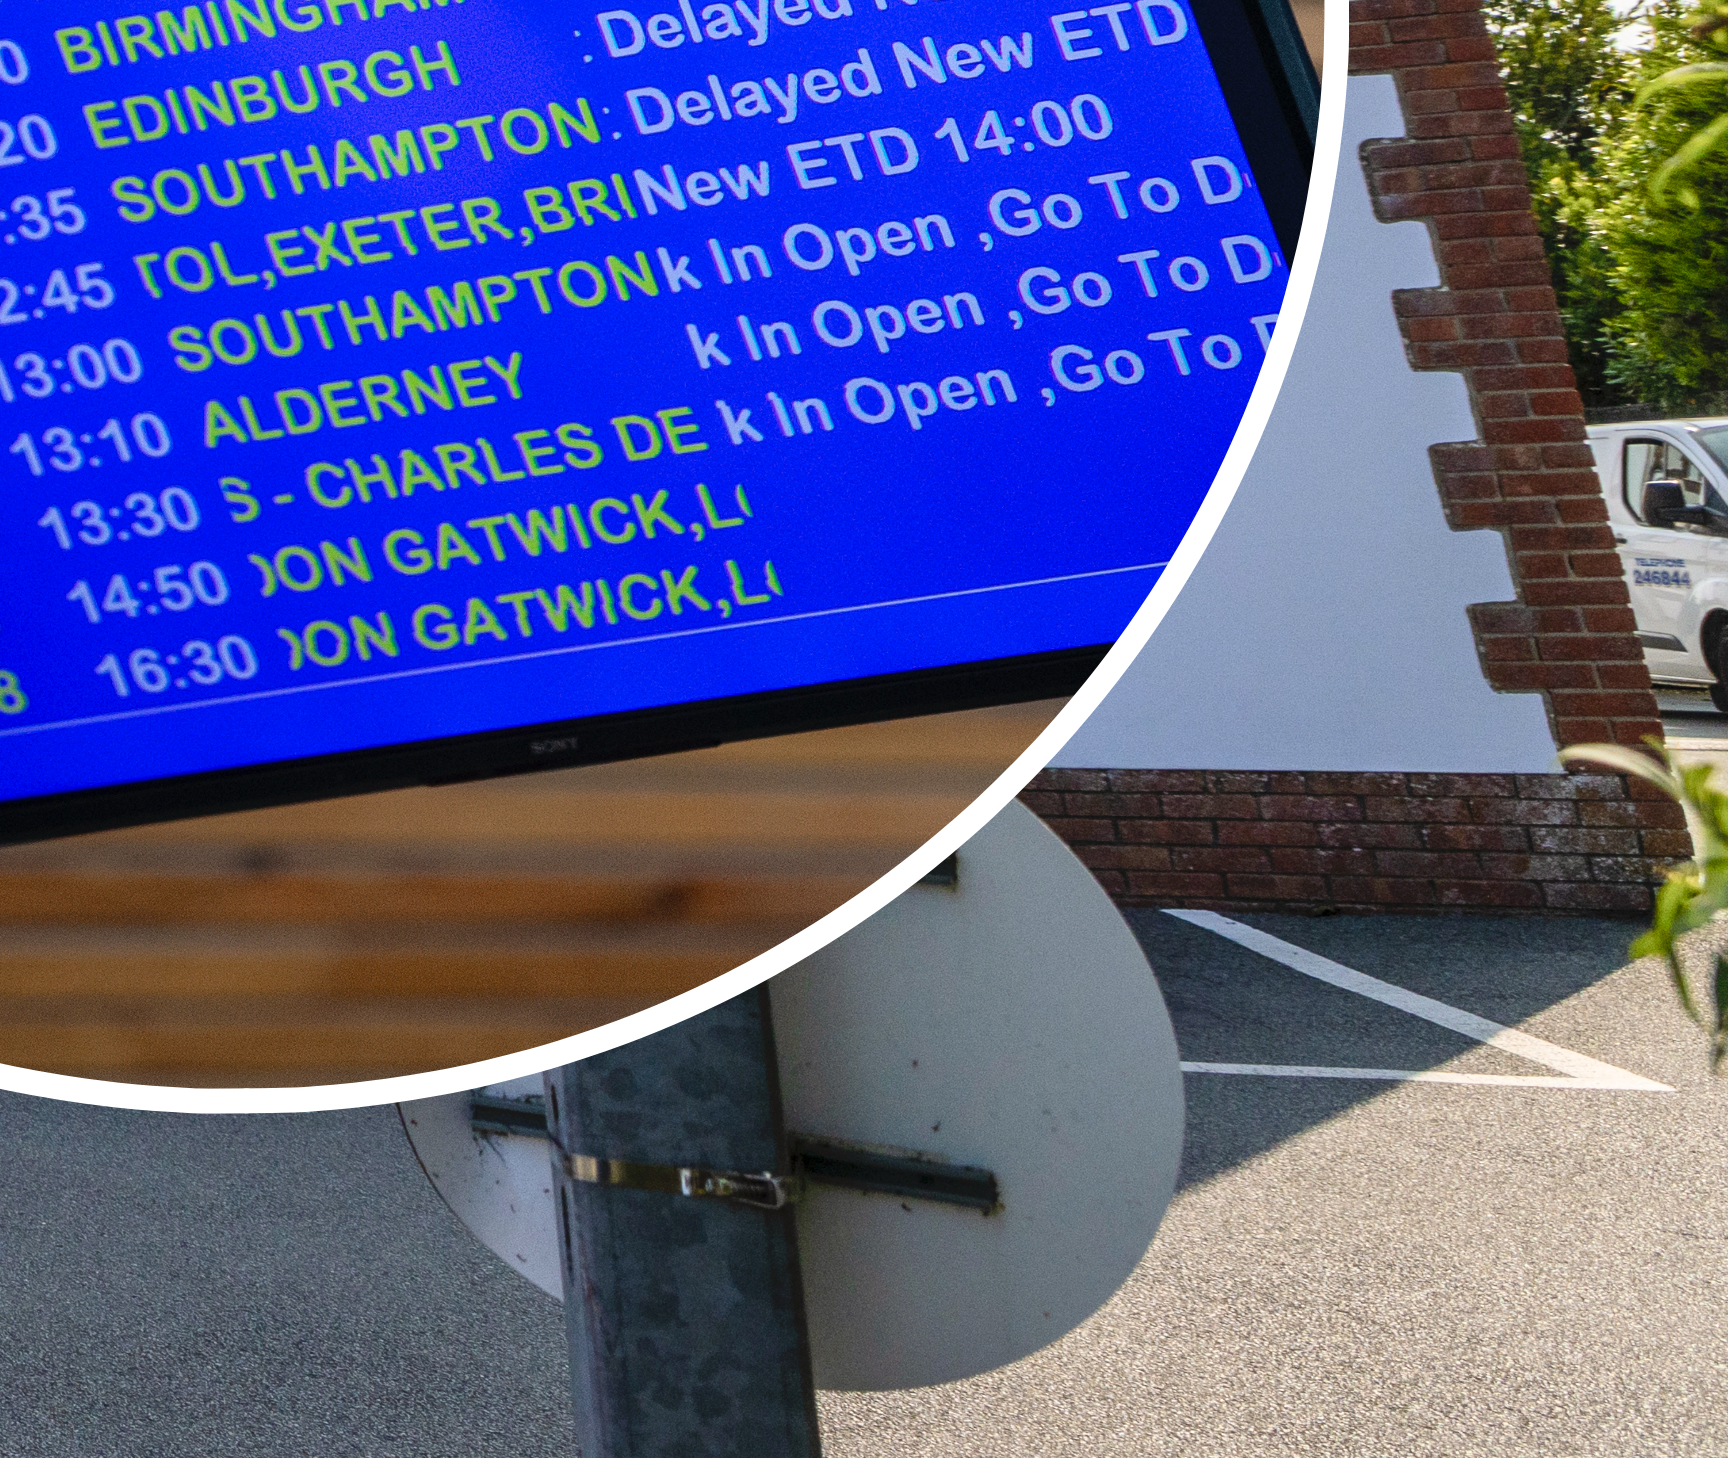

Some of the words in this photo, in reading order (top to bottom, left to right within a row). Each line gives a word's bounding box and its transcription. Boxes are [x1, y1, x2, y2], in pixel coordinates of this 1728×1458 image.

[84, 40, 462, 149] EDINBURGH
[113, 97, 602, 223] SOUTHAMPTON
[625, 47, 883, 136] Delayed
[891, 31, 1034, 89] New
[633, 159, 771, 217] New
[786, 126, 920, 190] ETD
[934, 92, 1114, 163] 14:00
[166, 248, 661, 372] SOUTHAMPTON
[708, 237, 773, 285] In
[783, 213, 956, 277] Open
[1087, 170, 1181, 220] To
[9, 411, 173, 476] 13:10
[203, 352, 523, 449] ALDERNEY
[685, 322, 732, 370] k
[737, 314, 803, 362] In
[812, 291, 986, 354] Open
[1117, 248, 1210, 298] To
[38, 486, 202, 551] 13:30
[305, 422, 604, 509] CHARLES
[611, 407, 709, 462] DE
[767, 391, 835, 438] In
[844, 368, 1018, 431] Open
[1147, 327, 1243, 376] To
[67, 560, 230, 623] 14:50
[384, 484, 753, 575] GATWICK,L
[95, 634, 258, 697] 16:30
[413, 560, 784, 651] GATWICK,L
